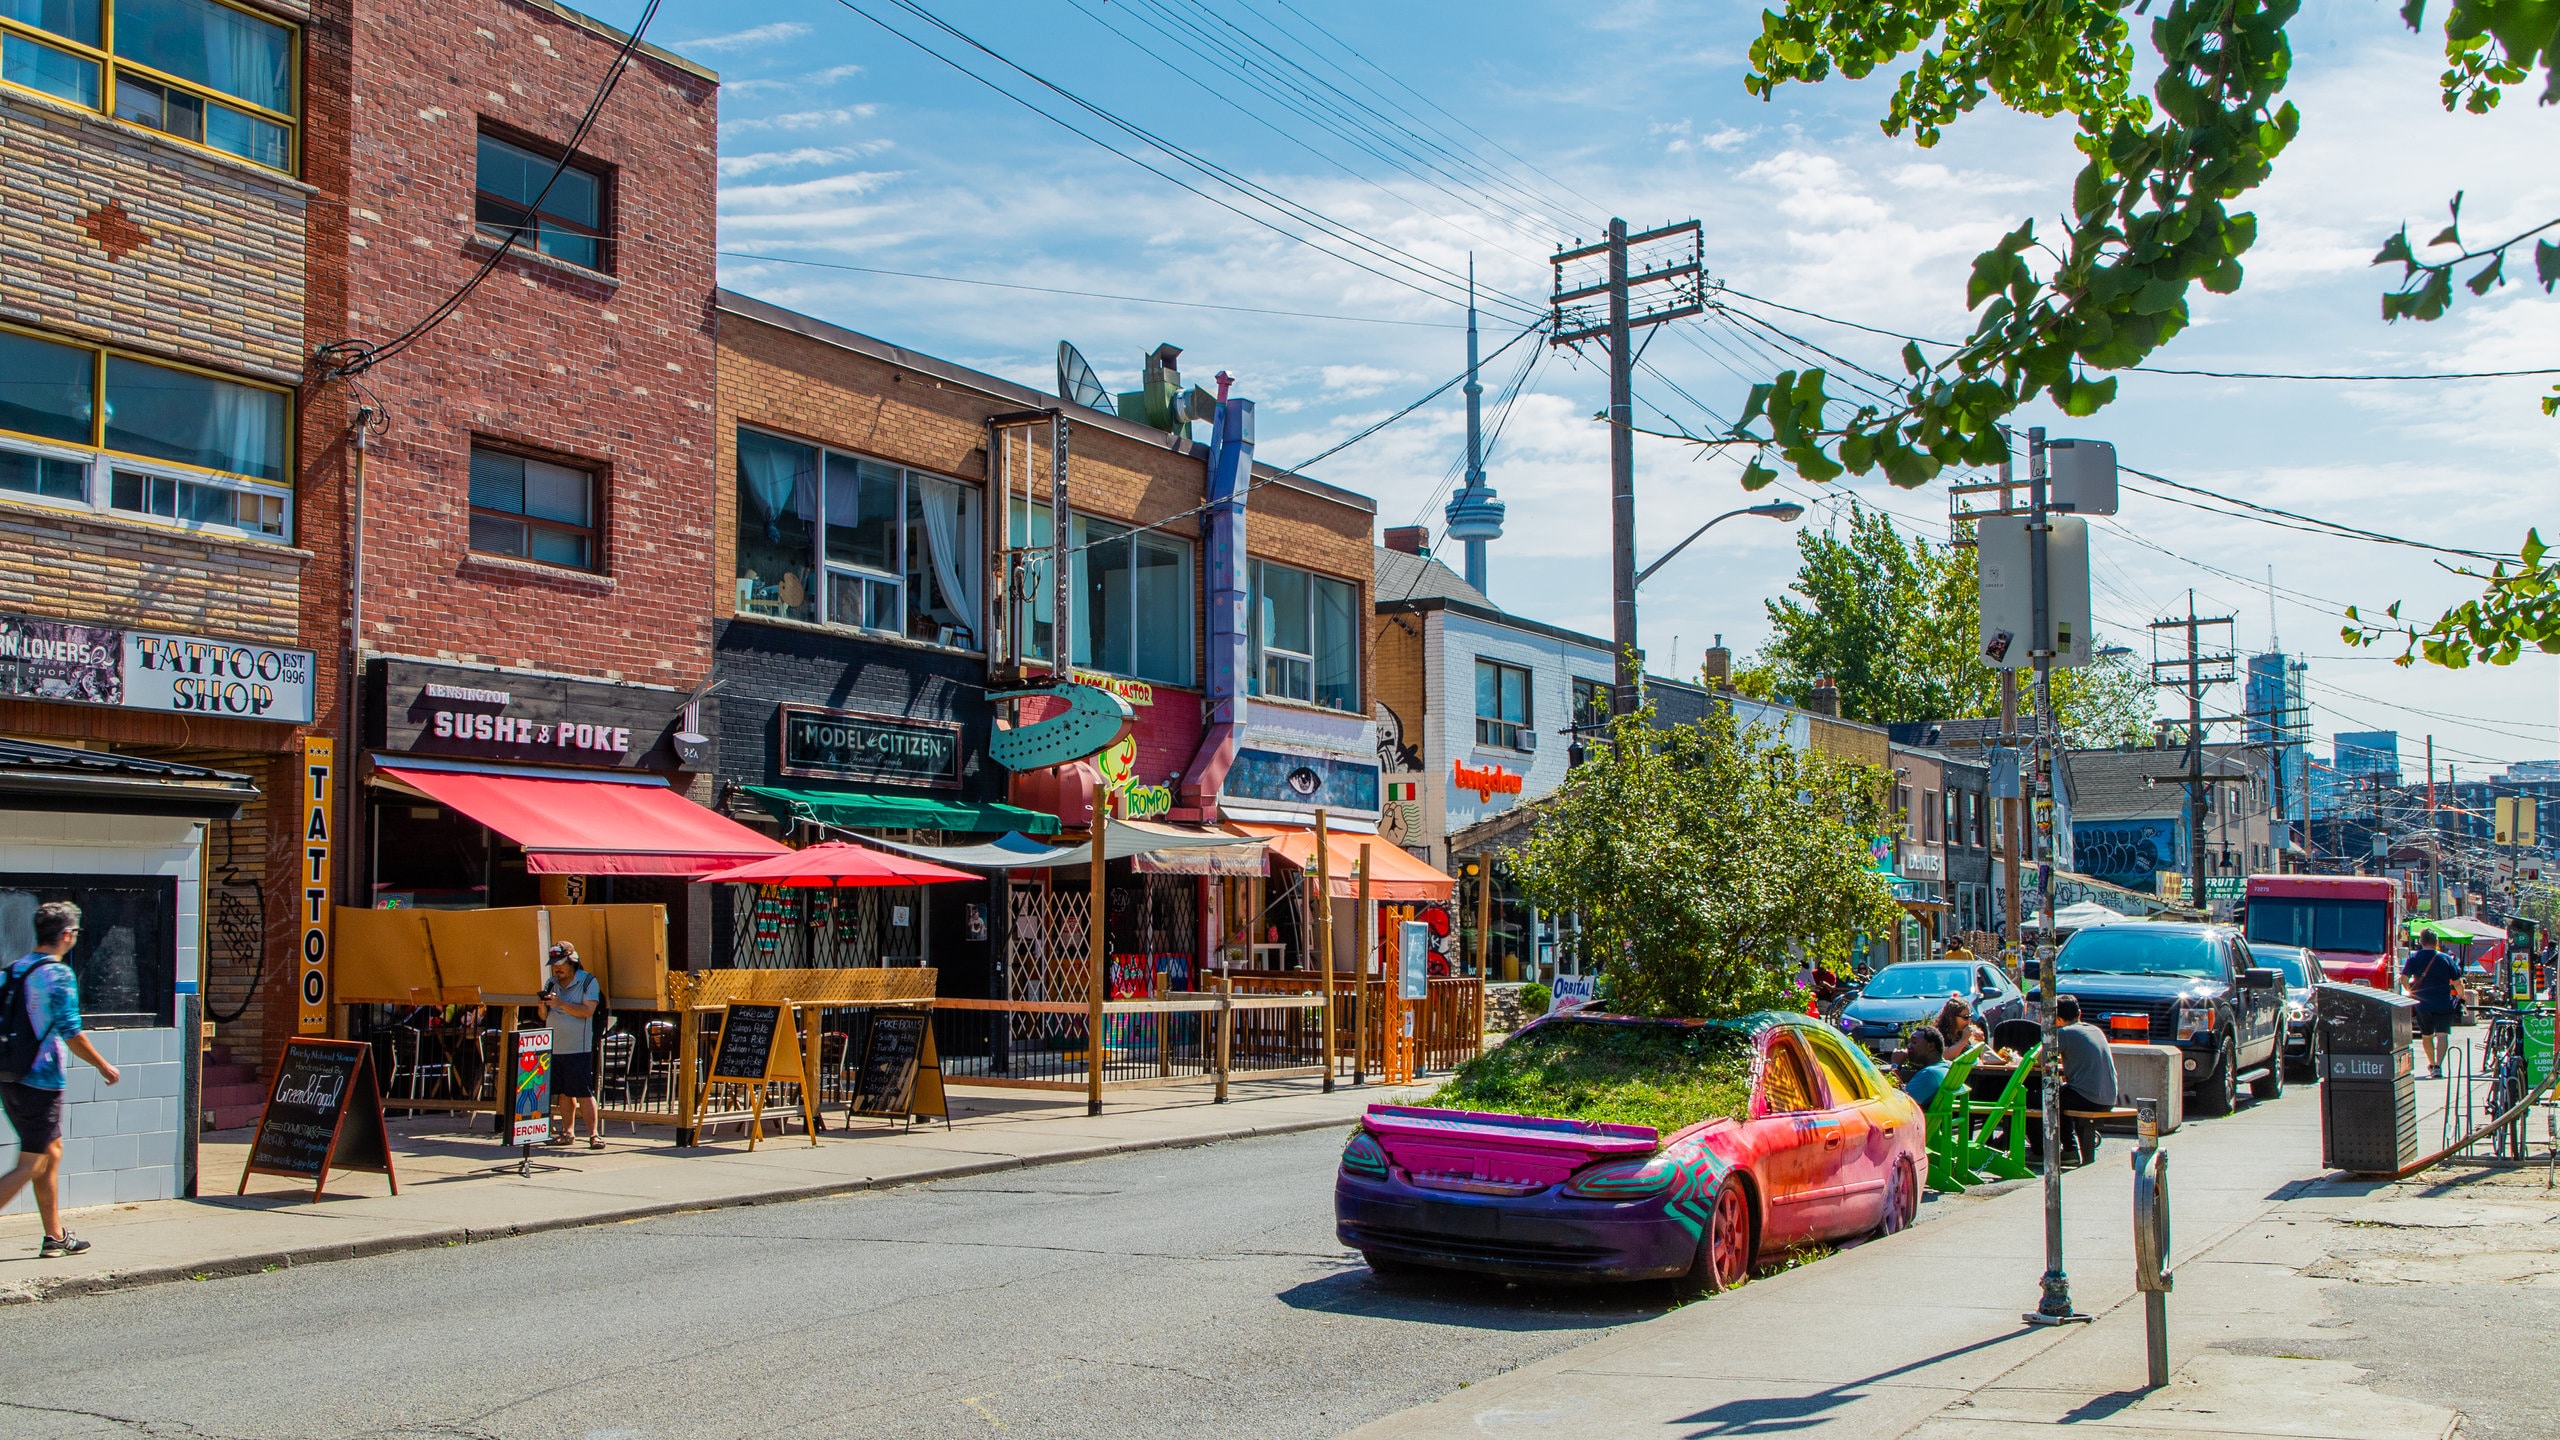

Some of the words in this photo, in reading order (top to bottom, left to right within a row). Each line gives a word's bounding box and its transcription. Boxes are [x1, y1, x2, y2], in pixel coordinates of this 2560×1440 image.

[136, 637, 282, 681] TATTOO
[28, 667, 66, 677] SHOP
[281, 669, 305, 685] 1996
[173, 677, 274, 716] SHOP
[425, 683, 510, 704] KENSINGTON
[1119, 683, 1150, 701] PASTOR
[434, 711, 532, 743] SUSHI
[537, 725, 550, 744] &
[557, 722, 629, 752] POKE
[805, 724, 866, 750] MODEL
[877, 733, 942, 758] CITIZEN
[1124, 778, 1170, 817] TROMPO
[1906, 853, 1943, 873] DENTIST
[302, 765, 329, 1006] TATTOO
[2205, 878, 2235, 888] FRUIT
[1553, 977, 1590, 999] ORBITAL
[518, 1033, 550, 1048] ATTOO
[2351, 1059, 2385, 1075] Litter
[514, 1124, 547, 1137] IERCING
